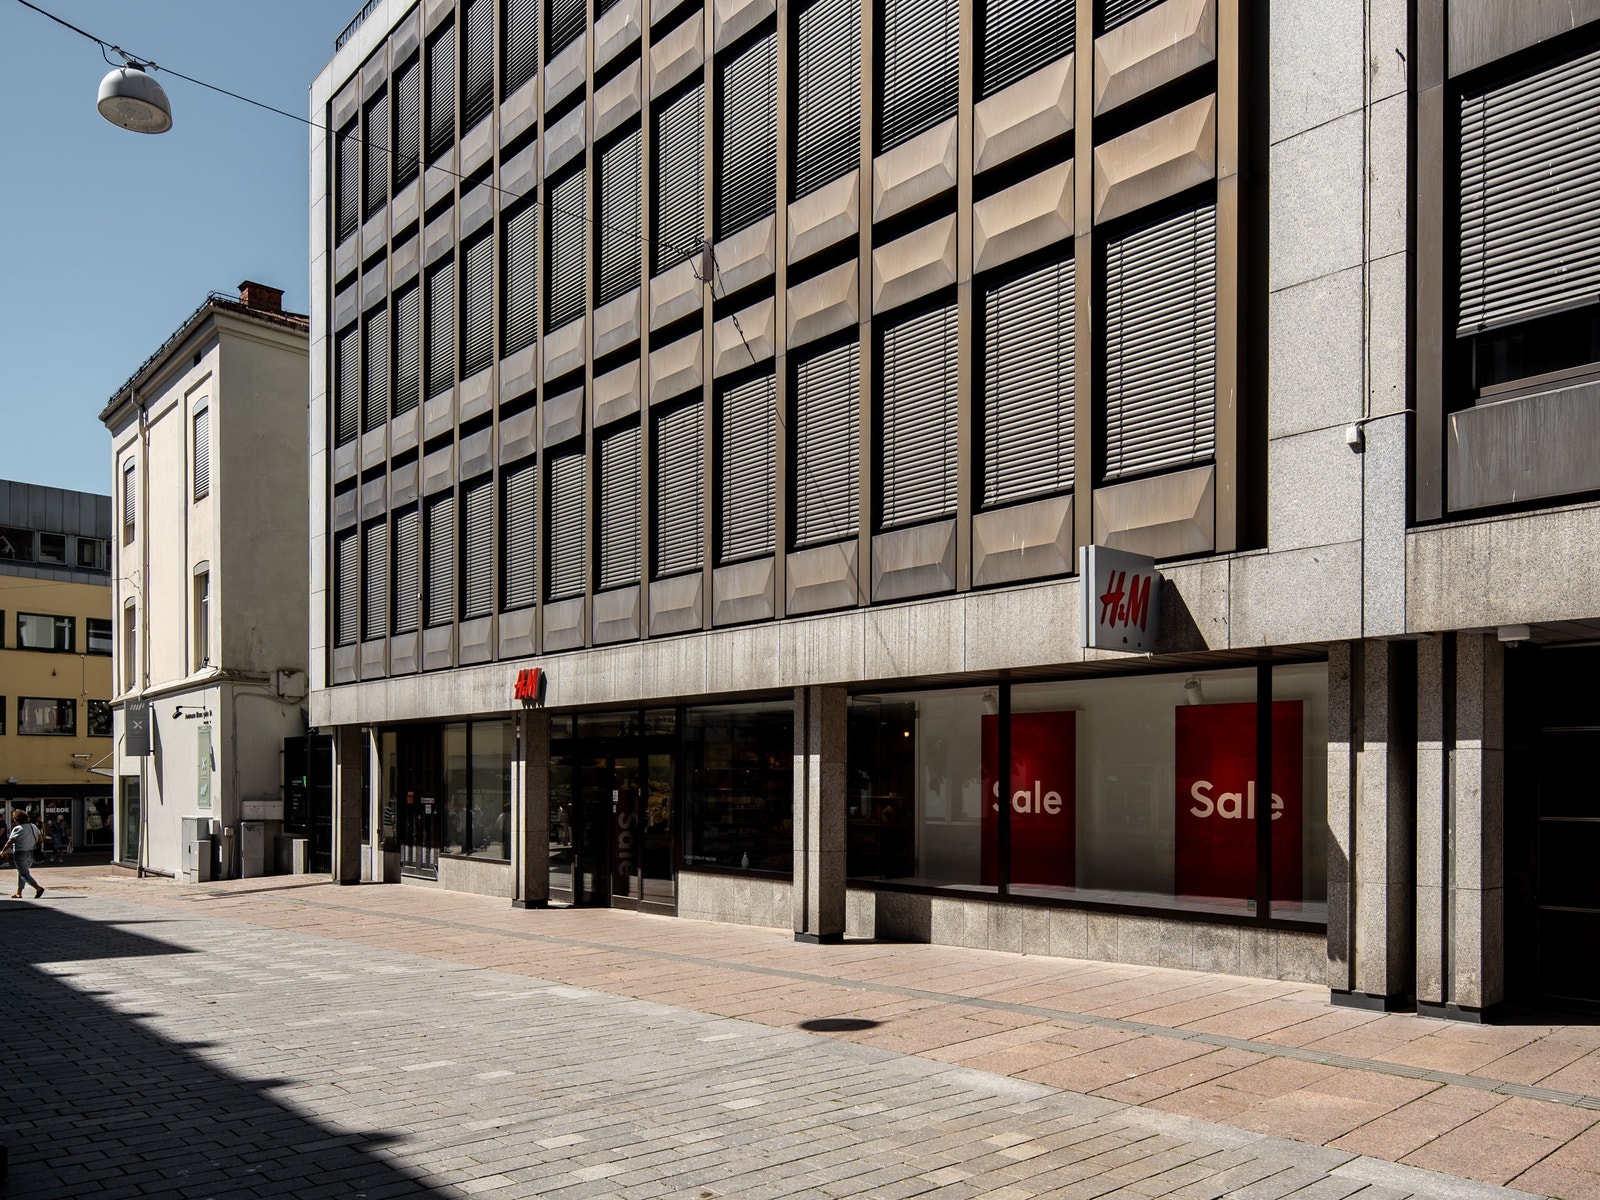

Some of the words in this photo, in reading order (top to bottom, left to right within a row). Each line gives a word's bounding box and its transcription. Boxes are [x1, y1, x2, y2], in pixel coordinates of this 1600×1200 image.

[1100, 570, 1151, 632] H&M
[514, 668, 539, 700] H&M
[618, 811, 637, 877] Sale
